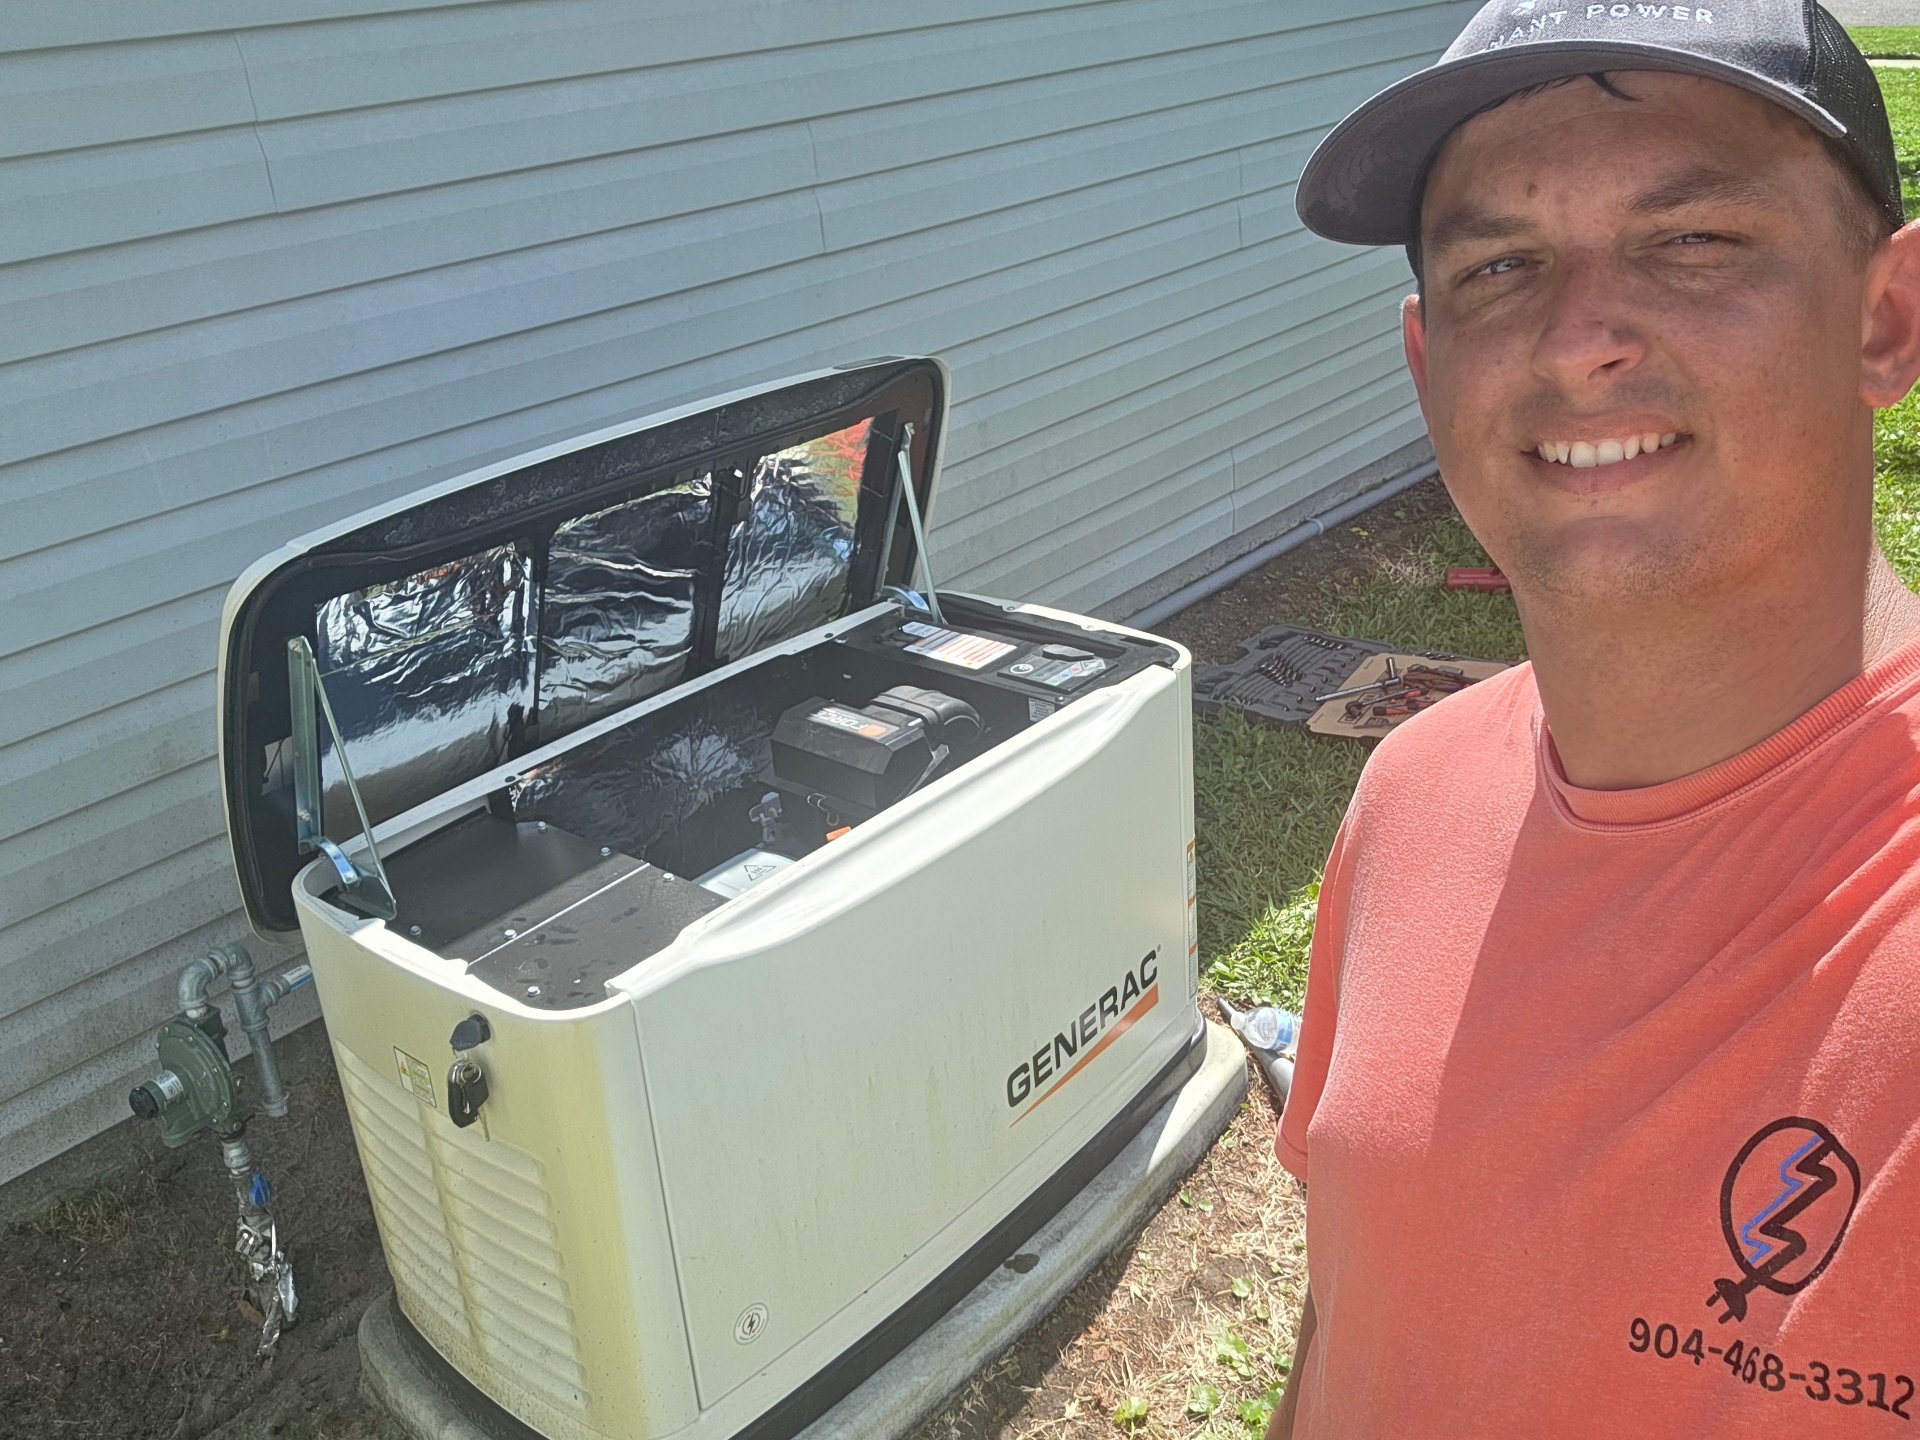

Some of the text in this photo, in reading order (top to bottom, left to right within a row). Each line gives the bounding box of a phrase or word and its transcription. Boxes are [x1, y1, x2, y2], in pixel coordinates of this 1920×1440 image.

[1586, 3, 1713, 24] POWER
[1007, 949, 1159, 1108] GENERAC
[1628, 1317, 1915, 1421] 904-468-3312
